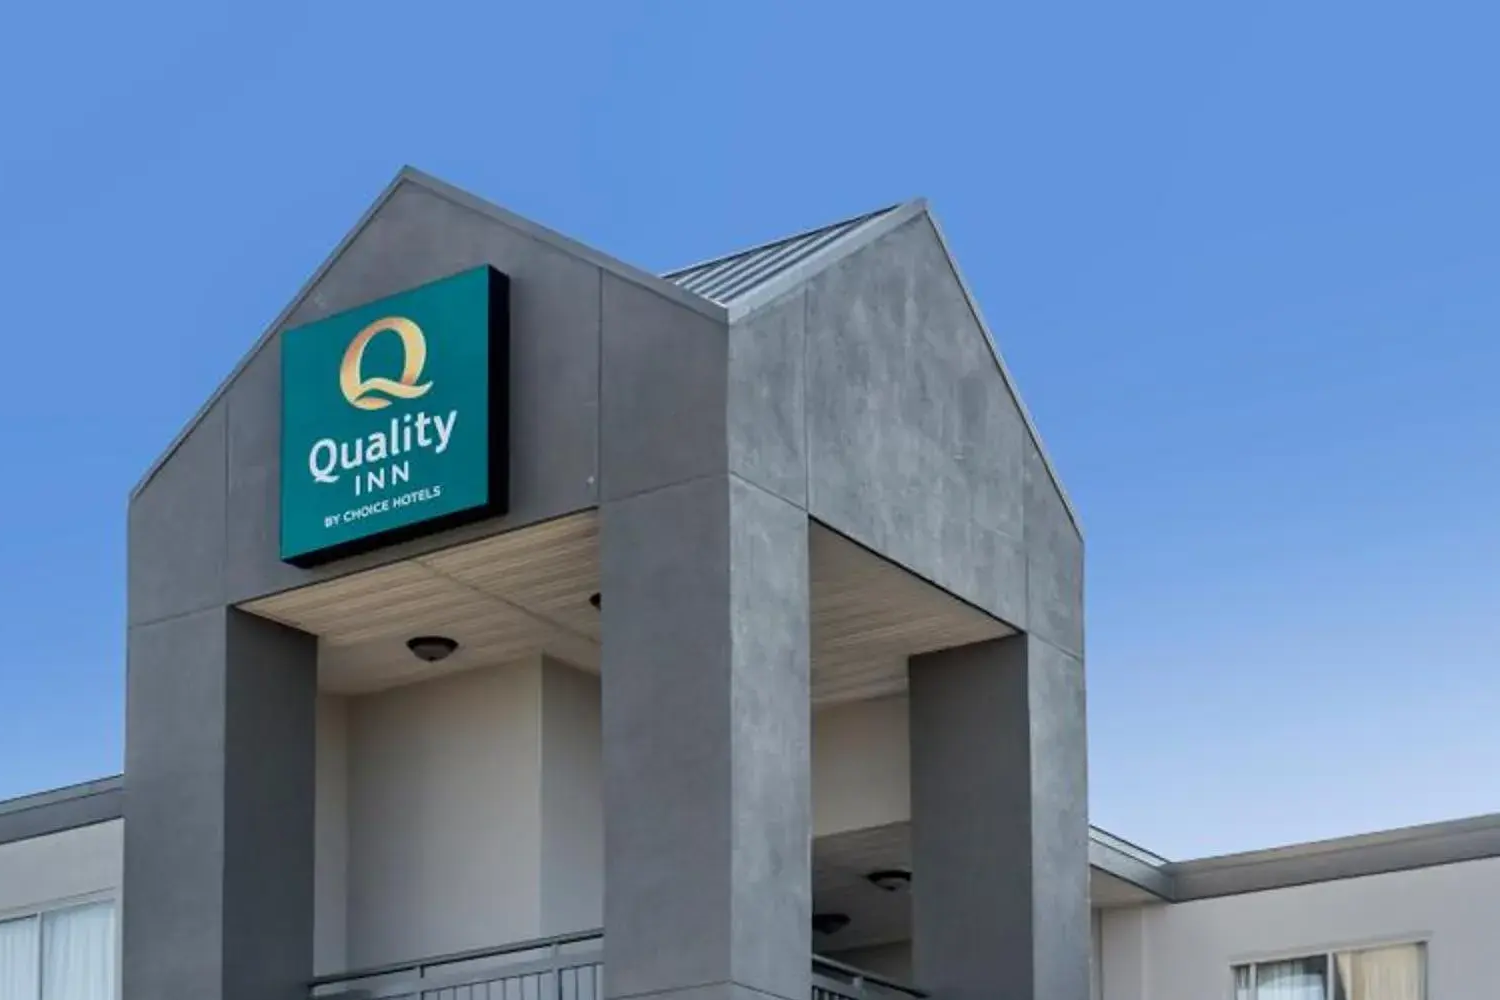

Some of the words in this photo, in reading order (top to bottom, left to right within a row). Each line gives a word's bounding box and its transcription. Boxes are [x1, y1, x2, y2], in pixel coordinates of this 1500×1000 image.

[339, 316, 433, 410] Q
[309, 410, 457, 483] Quality
[324, 513, 341, 528] BY
[343, 500, 389, 523] CHOICE
[393, 485, 441, 508] HOTELS
[355, 461, 410, 496] INN
